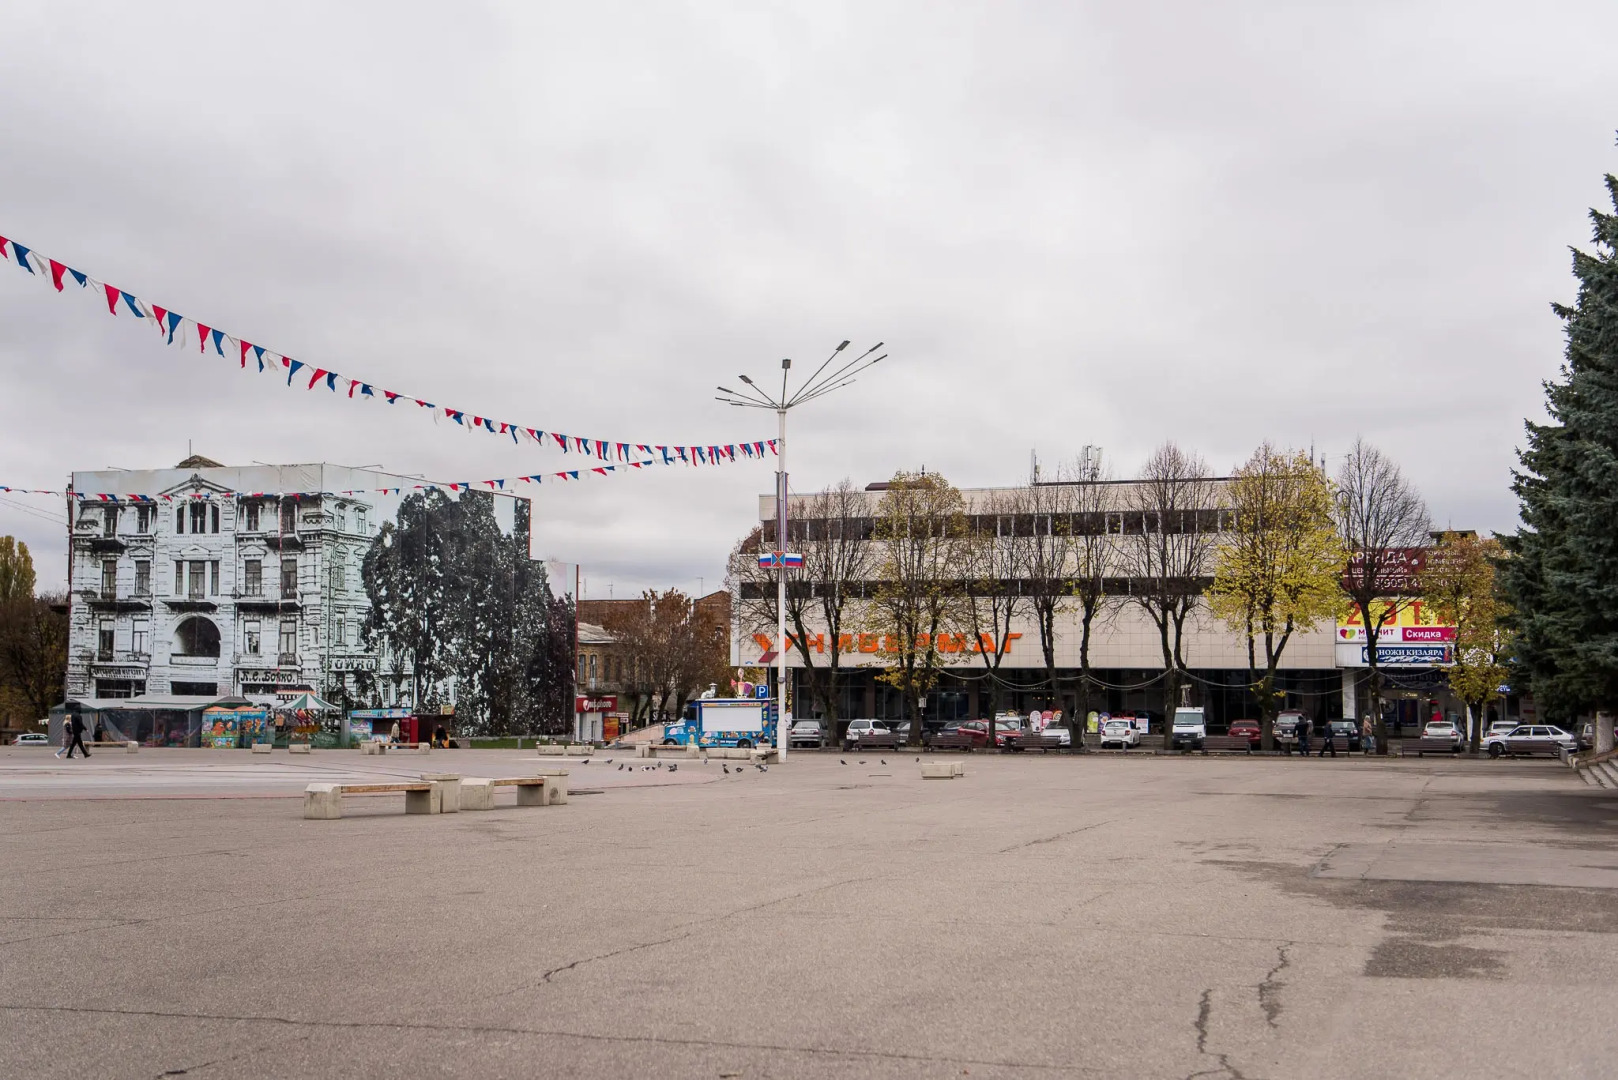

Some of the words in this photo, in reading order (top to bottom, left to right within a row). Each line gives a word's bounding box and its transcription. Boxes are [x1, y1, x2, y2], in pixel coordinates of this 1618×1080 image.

[1358, 628, 1395, 636] МГНИТ
[1405, 629, 1442, 640] Скидка
[758, 686, 766, 697] P
